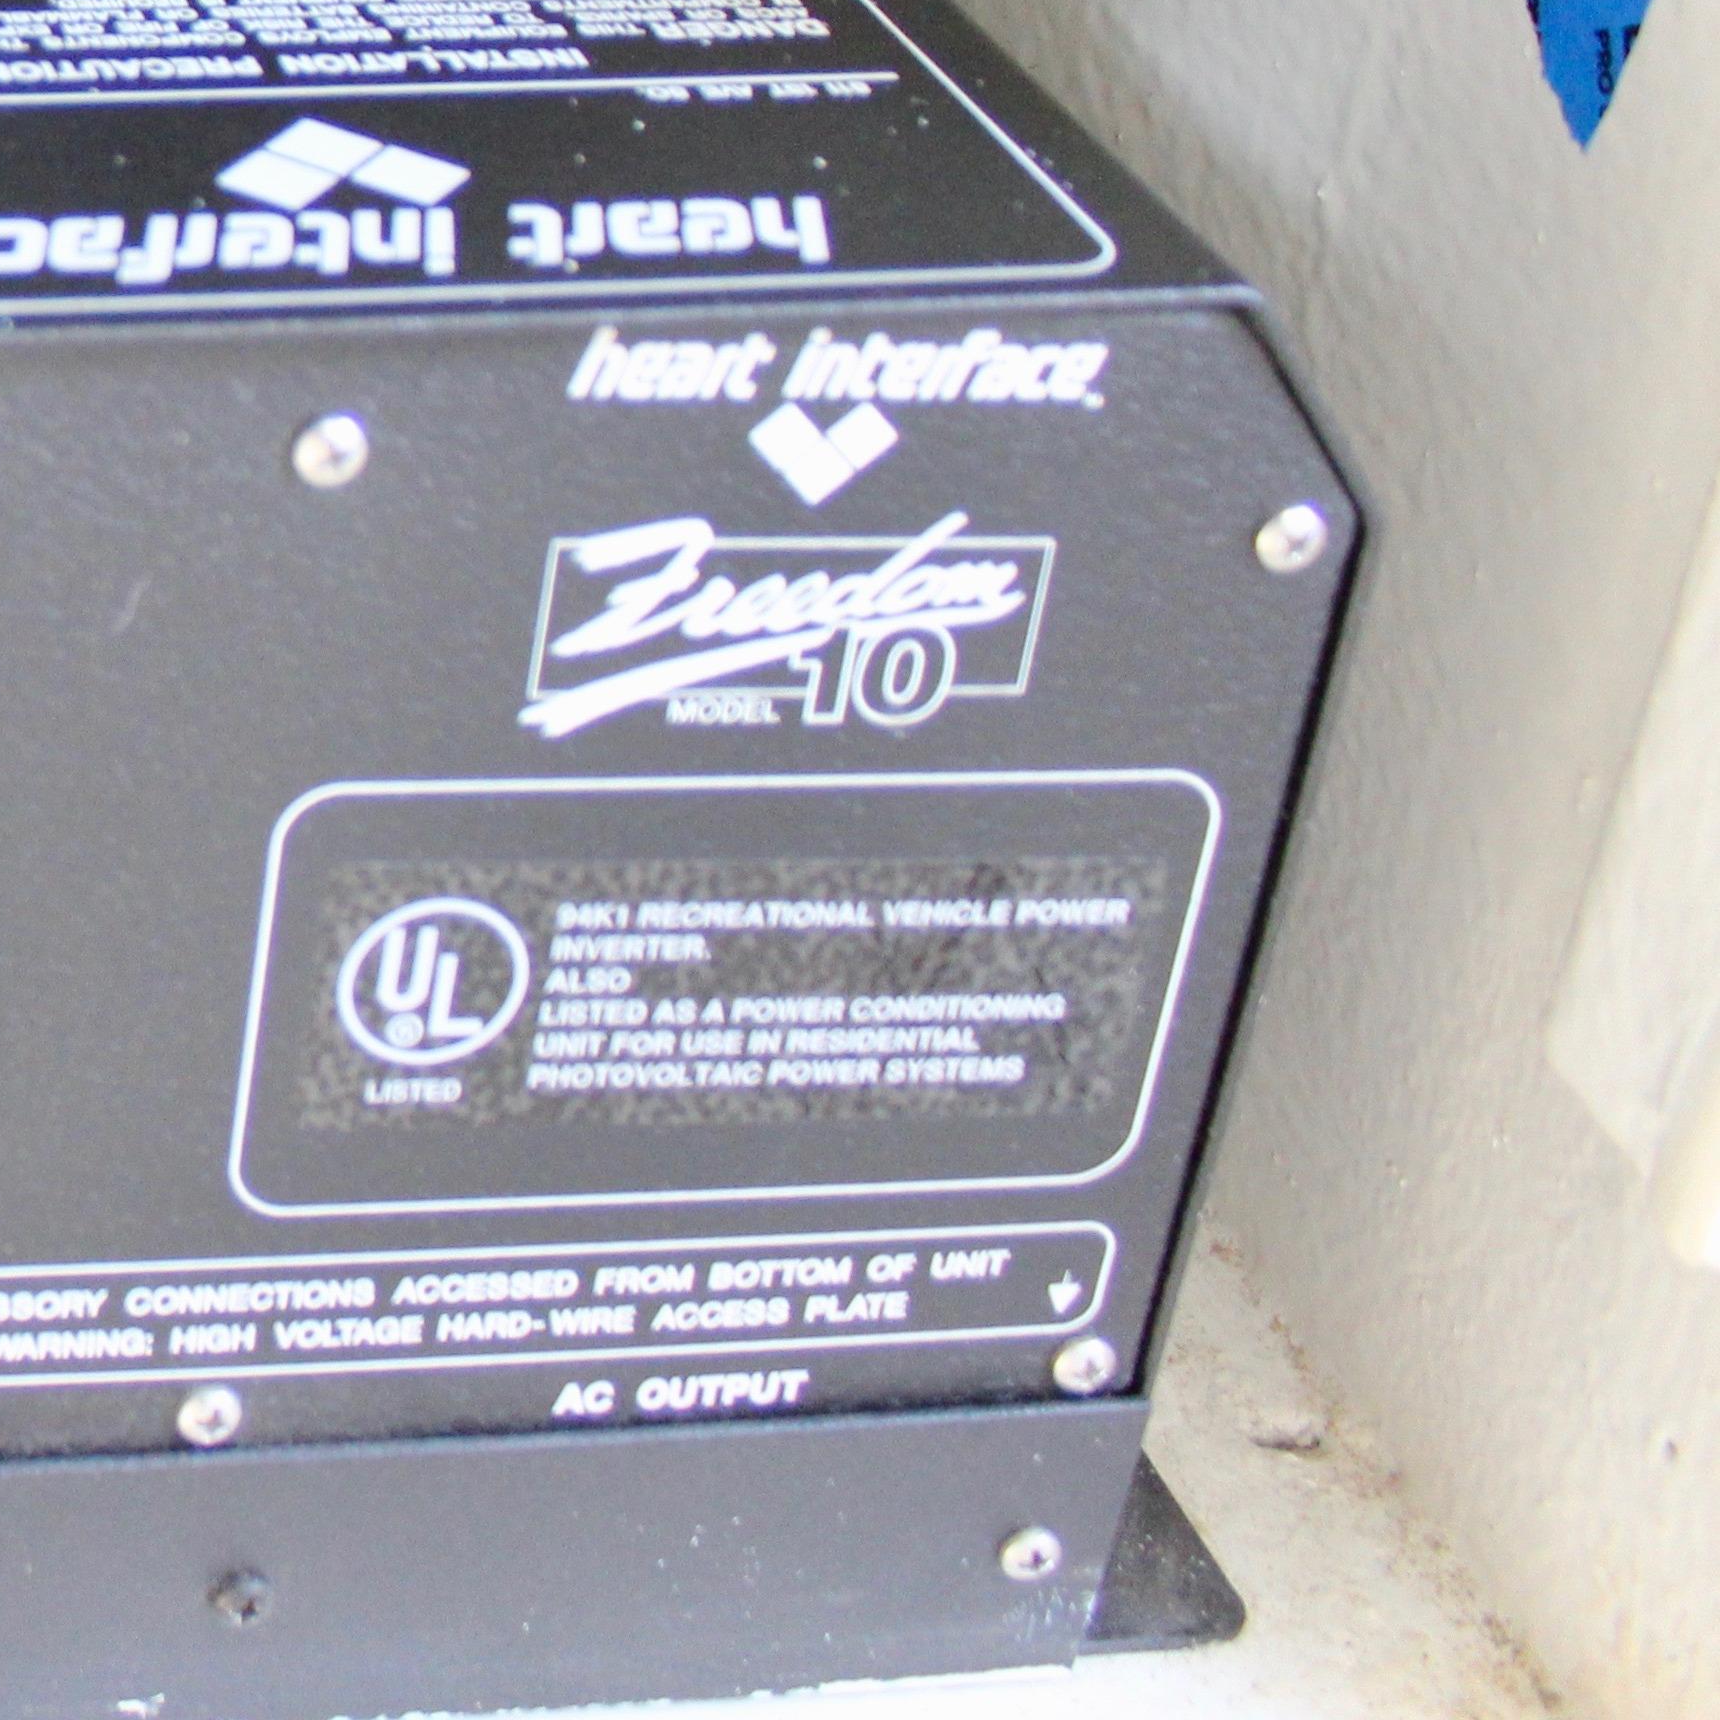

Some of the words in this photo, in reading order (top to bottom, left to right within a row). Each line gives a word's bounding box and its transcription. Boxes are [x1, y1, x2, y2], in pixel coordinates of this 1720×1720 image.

[646, 16, 829, 42] DANGER
[279, 47, 589, 74] INSTALLATION
[508, 196, 830, 271] heart
[567, 325, 776, 401] heart
[782, 328, 1109, 404] interface
[551, 510, 1029, 658] Freedom
[665, 697, 780, 724] MODEL
[787, 625, 959, 728] 10
[637, 902, 871, 928] RECREATIONAL
[883, 900, 1011, 927] VEHICLE
[1017, 899, 1129, 926] POWER
[551, 936, 711, 962] INVERTER.
[545, 969, 632, 993] ALSO
[539, 999, 645, 1024] LISTED
[651, 998, 696, 1022] AS
[701, 998, 725, 1022] A
[730, 997, 845, 1023] POWER
[851, 994, 1065, 1021] CONDITIONING
[534, 1030, 605, 1056] UNIT
[611, 1029, 676, 1055] FOR
[683, 1028, 744, 1054] USE
[750, 1028, 785, 1053] IN
[789, 1026, 978, 1053] RESIDENTIAL
[528, 1062, 763, 1089] PHOTOVOLTAIC
[768, 1060, 880, 1087] POWER
[886, 1057, 1023, 1085] SYSTEMS
[365, 1078, 462, 1103] LISTED
[124, 1278, 375, 1317] CONNECTIONS
[391, 1269, 579, 1305] ACCESSED
[594, 1264, 695, 1295] FROM
[708, 1256, 853, 1291] BOTTOM
[867, 1253, 917, 1283] OF
[930, 1249, 1011, 1280] UNIT
[169, 1323, 256, 1354] HIGH
[274, 1315, 424, 1349] VOLTAGE
[436, 1301, 636, 1342] HARD-WIRE
[651, 1297, 790, 1331] ACCESS
[804, 1291, 909, 1323] PLATE
[552, 1380, 615, 1415] AC
[635, 1369, 810, 1412] OUTPUT
